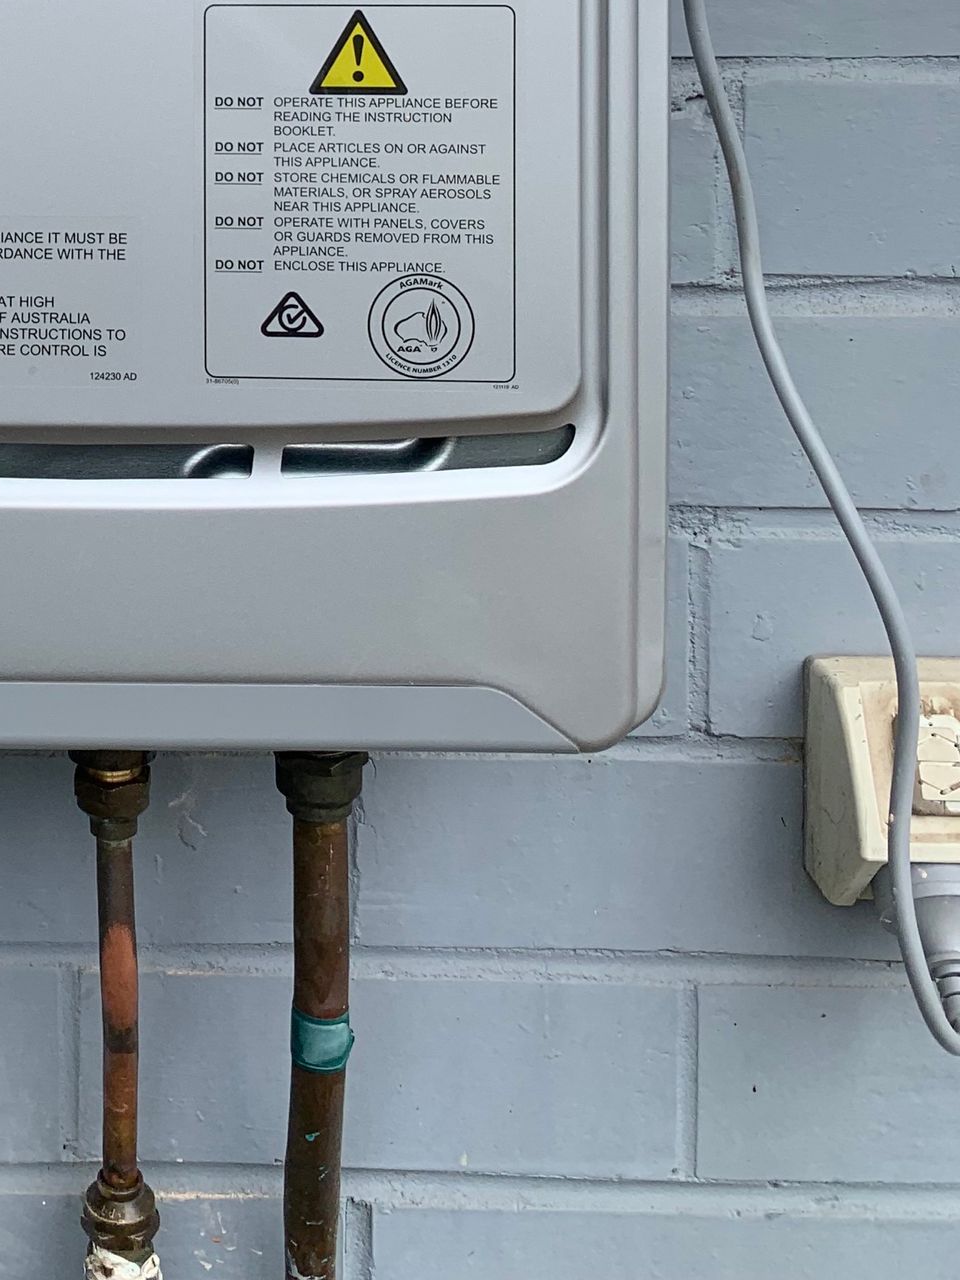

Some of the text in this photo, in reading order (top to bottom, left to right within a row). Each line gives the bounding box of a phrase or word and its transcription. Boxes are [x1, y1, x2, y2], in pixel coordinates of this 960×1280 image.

[215, 95, 497, 108] DO NOT OPERATE THIS APPLIANCE BEFORE
[274, 111, 451, 123] READING THE INSTRUCTION
[273, 125, 335, 136] BOOKLET.
[215, 141, 486, 154] DO NOT PLACE ARTICLES ON OR AGAINST
[273, 156, 379, 168] THIS APPLIANCE.
[215, 171, 500, 185] DO NOT STORE CHEMICALS OR FLAMMABLE
[274, 186, 491, 199] MATERIALS, OR SPRAY AEROSOLS
[274, 201, 419, 213] NEAR THIS APPLIANCE.
[215, 216, 485, 230] DO NOT OPERATE WITH PANELS, COVERS
[48, 231, 60, 243] IT
[64, 232, 104, 244] MUST
[109, 232, 127, 244] BE
[273, 231, 493, 244] OR GUARDS REMOVED FROM THIS
[57, 248, 93, 259] WITH
[97, 248, 125, 260] THE
[273, 245, 347, 257] APPLIANCE.
[215, 259, 445, 273] DO NOT ENCLOSE THIS APPLIANCE.
[399, 278, 444, 290] AGAMark
[19, 295, 54, 308] HIGH
[10, 311, 90, 324] AUSTRALIA
[106, 328, 126, 341] TO
[19, 343, 89, 356] CONTROL
[93, 345, 106, 356] IS
[397, 345, 421, 353] AGA
[385, 353, 411, 372] LICENCE
[412, 365, 442, 374] NUMBER
[90, 371, 137, 380] 124230 AD
